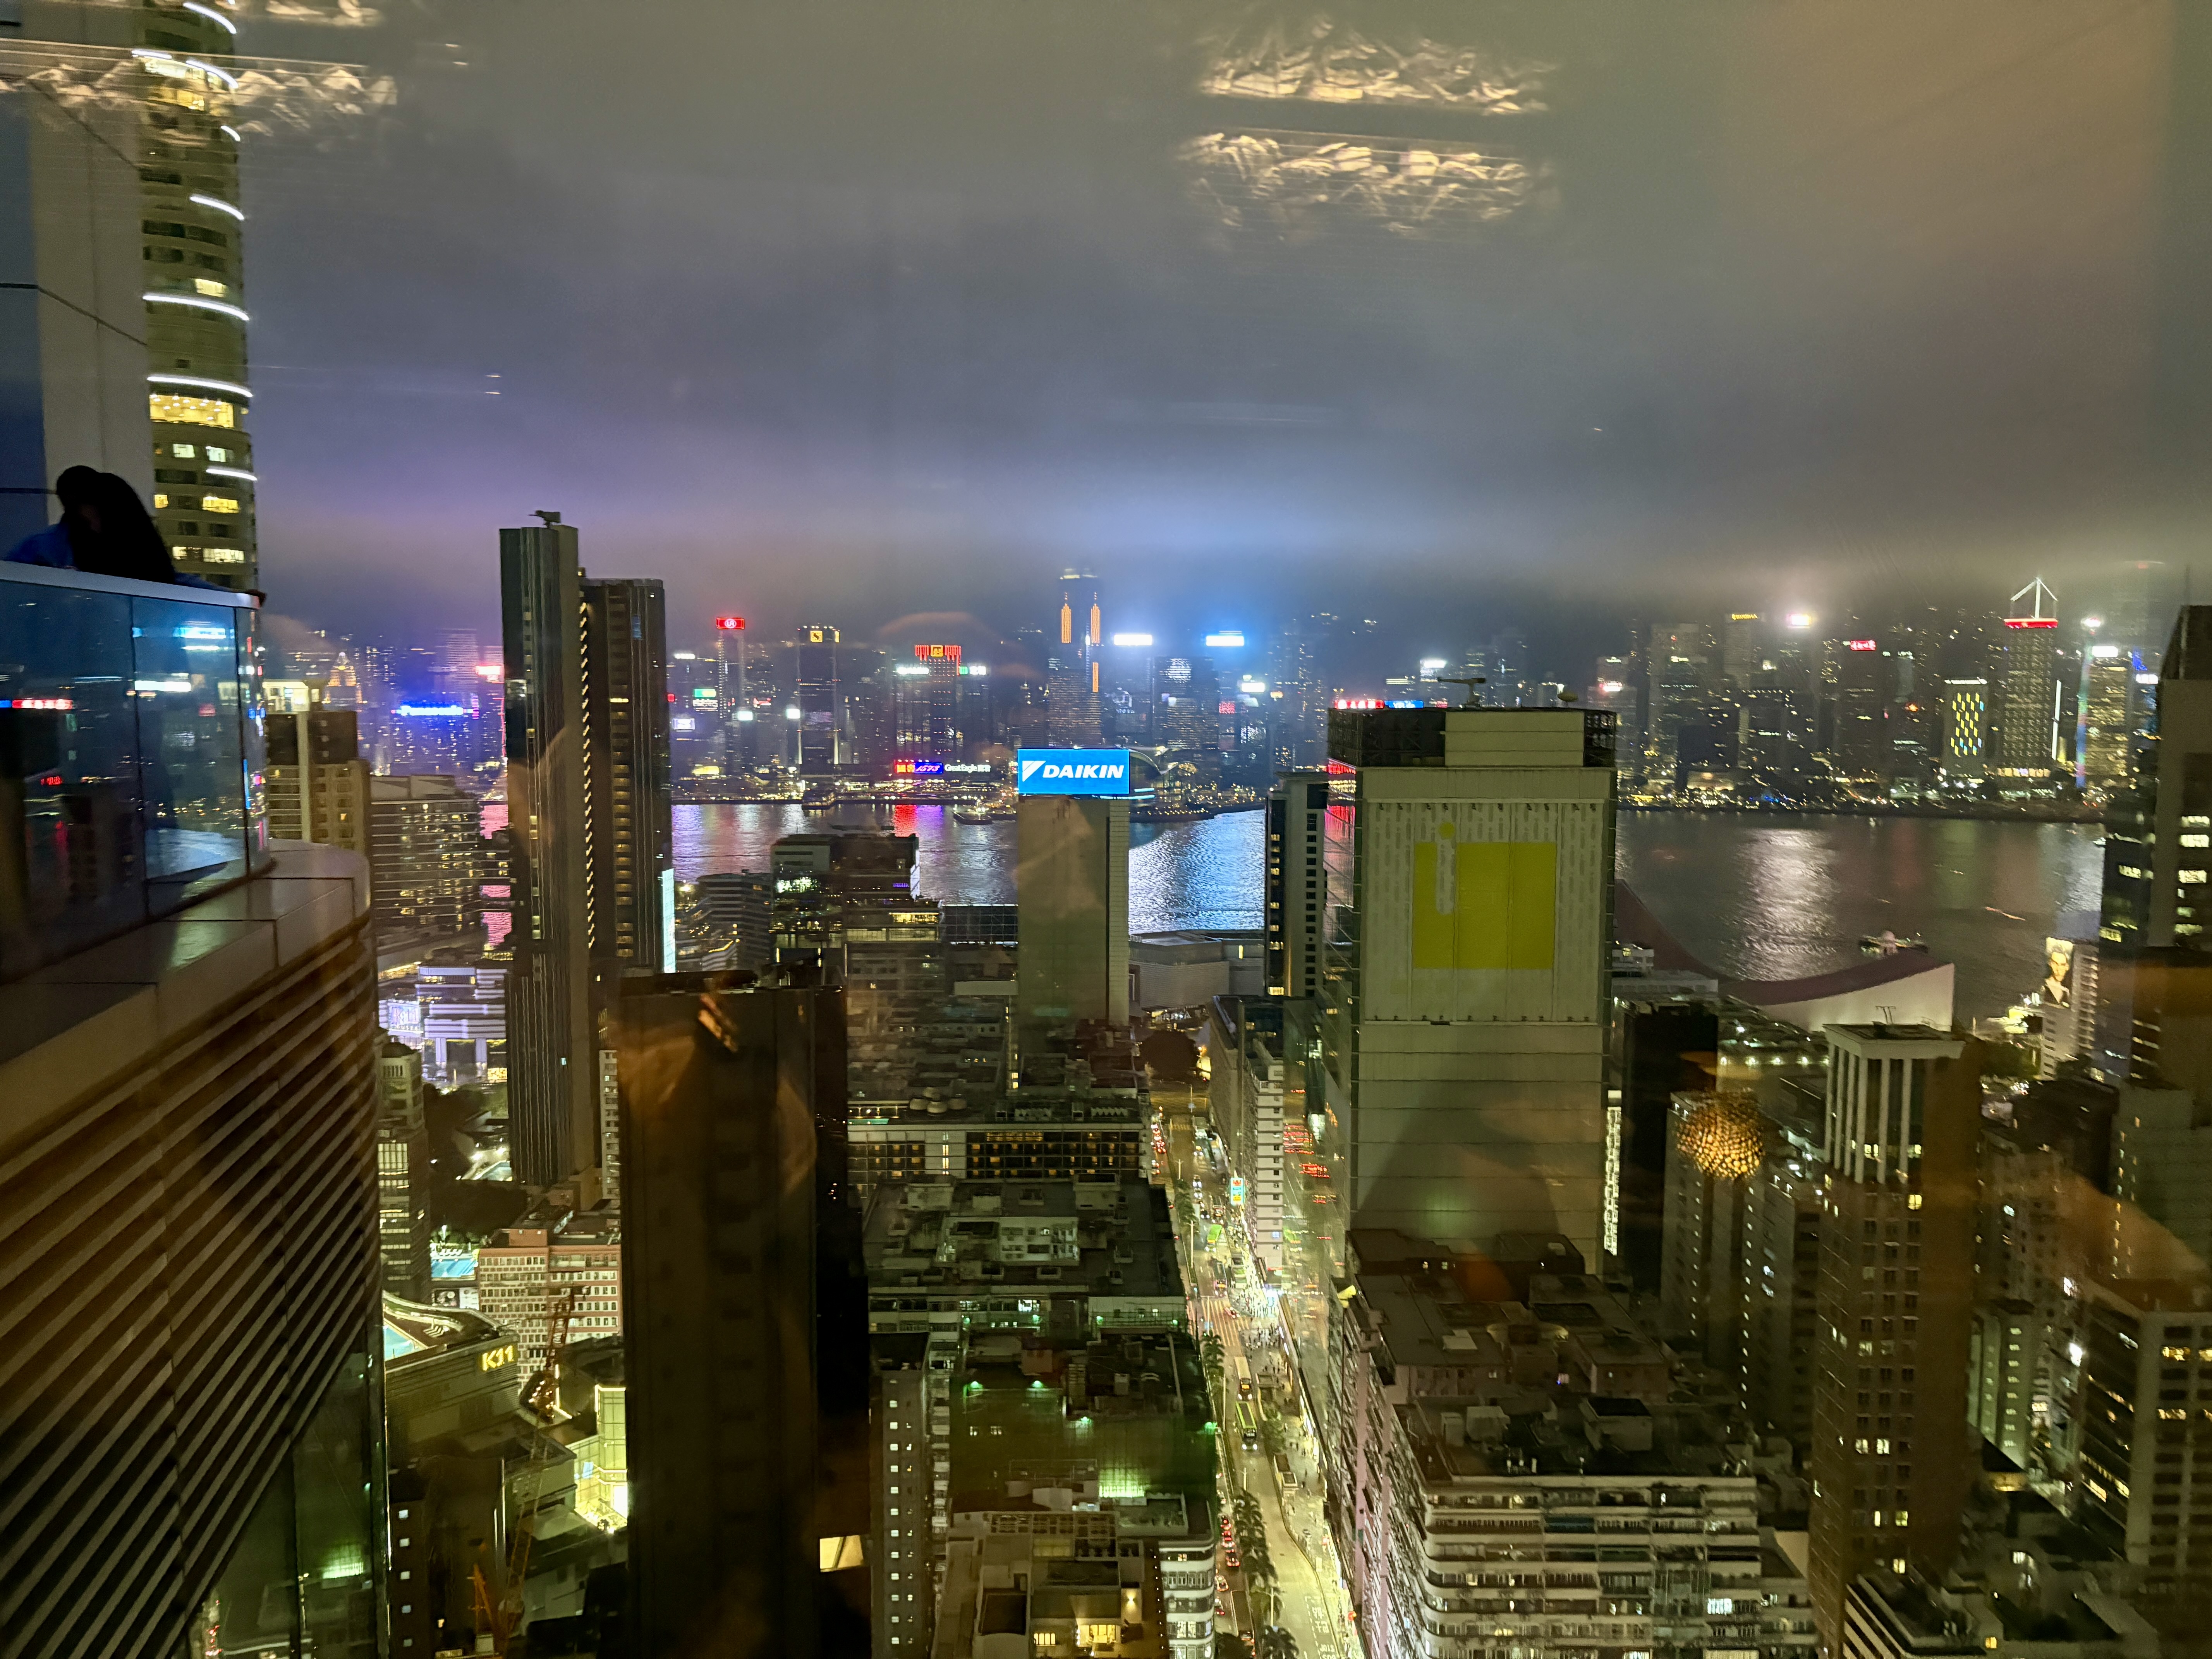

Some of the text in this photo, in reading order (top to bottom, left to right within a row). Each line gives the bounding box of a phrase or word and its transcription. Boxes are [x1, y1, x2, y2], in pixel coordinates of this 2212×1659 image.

[961, 764, 977, 773] Eagle
[1042, 765, 1124, 778] DAIKIN
[483, 1345, 514, 1371] K11
